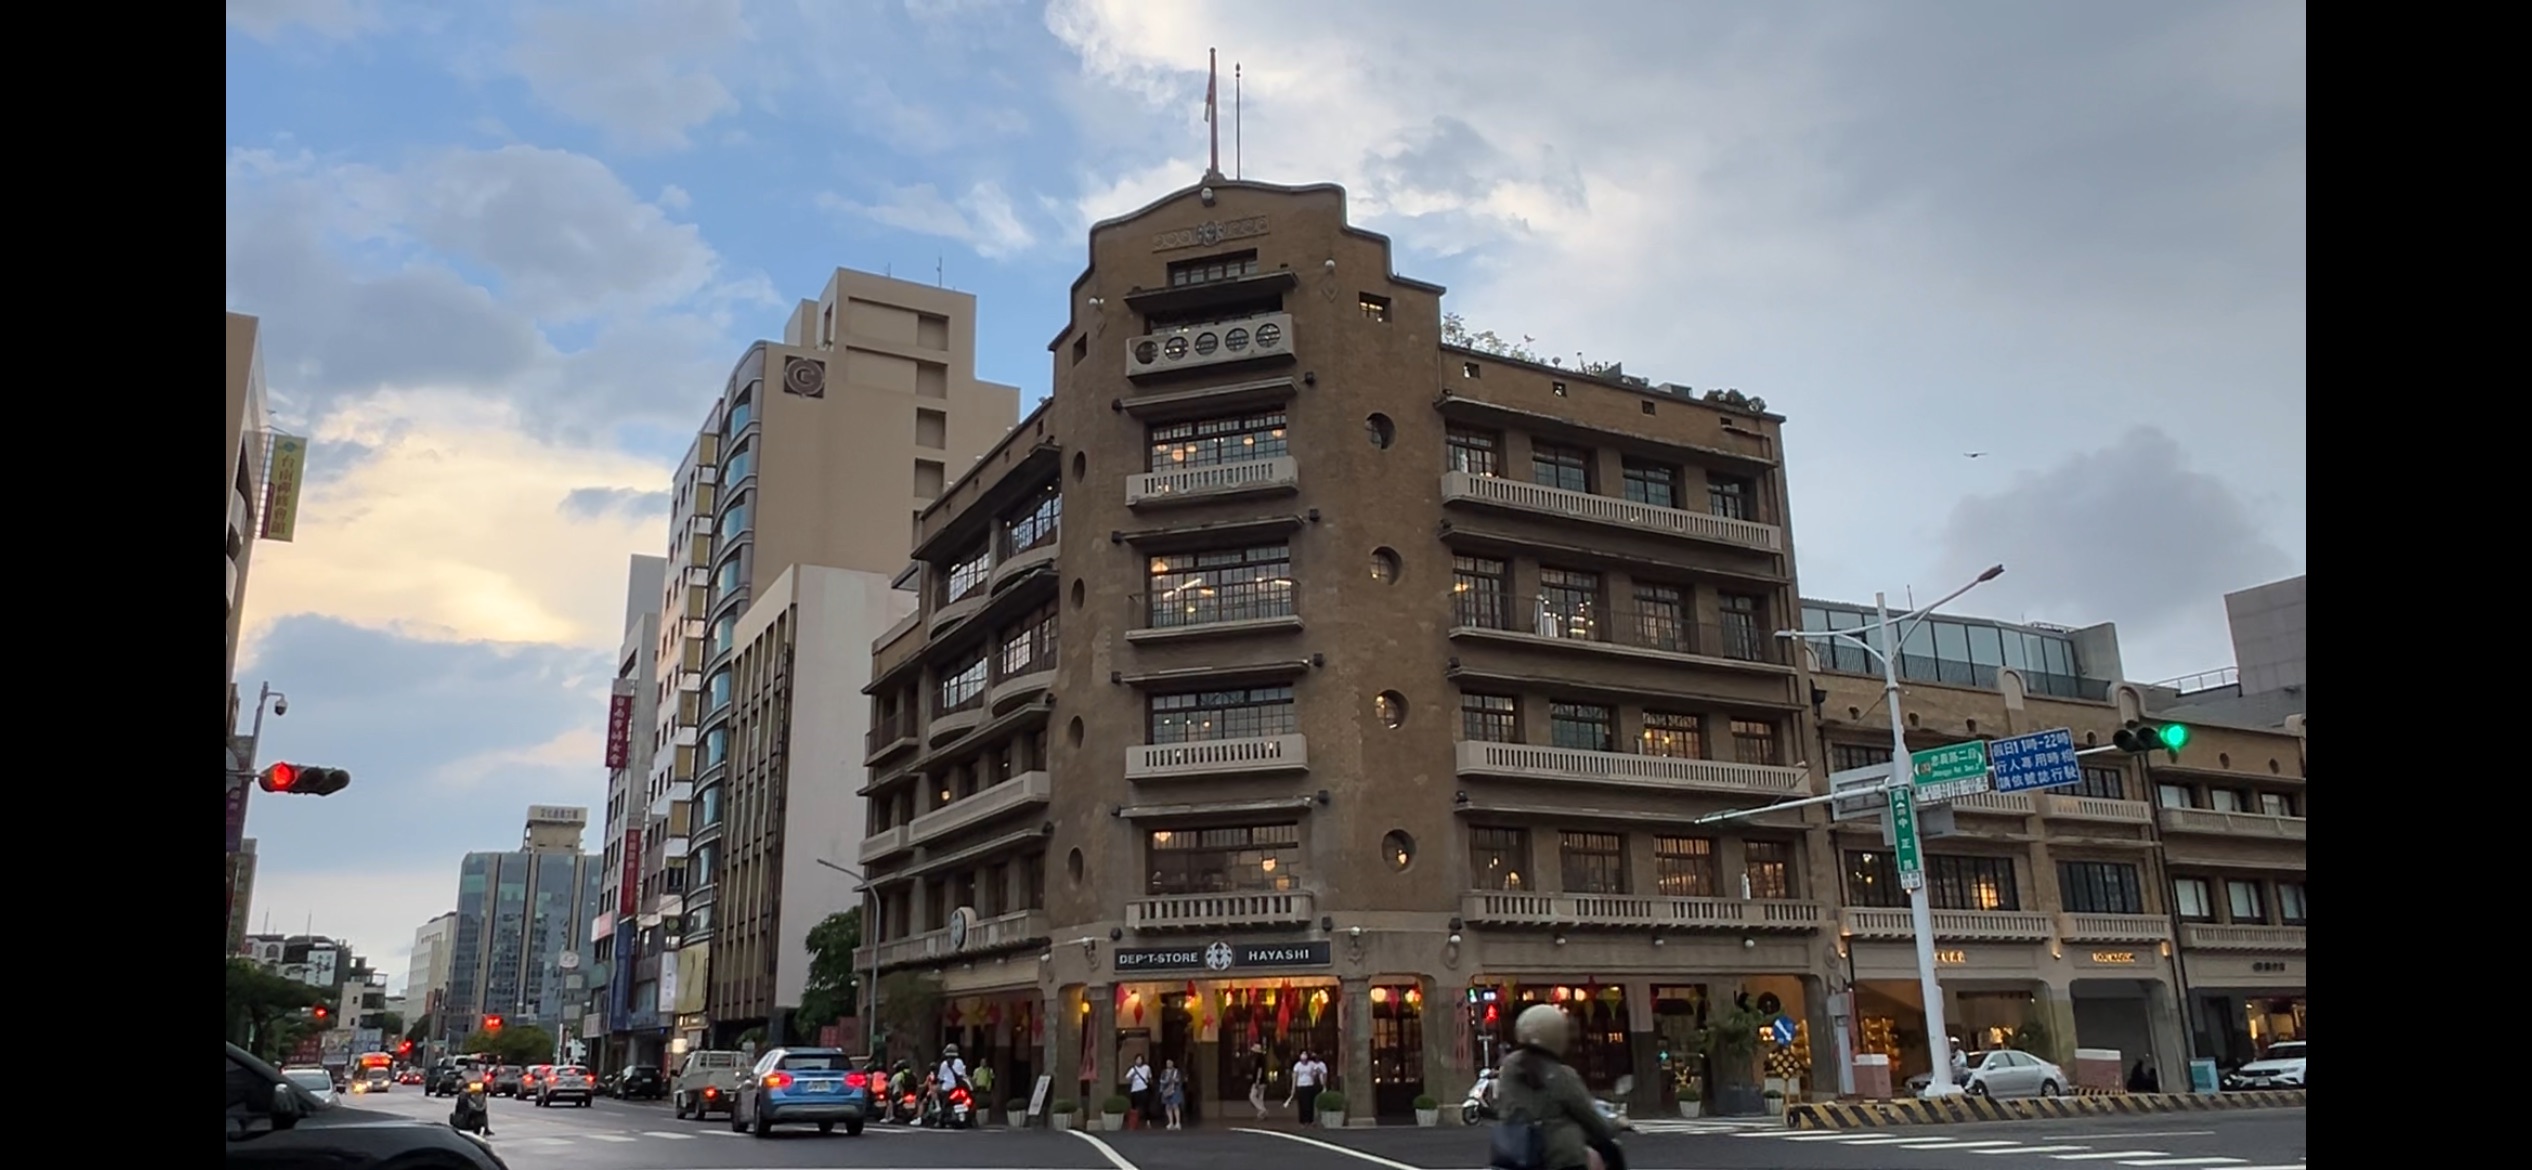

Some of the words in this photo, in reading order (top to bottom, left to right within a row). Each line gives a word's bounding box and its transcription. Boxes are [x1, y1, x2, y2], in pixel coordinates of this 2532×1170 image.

[1995, 749, 2075, 772] 行人專用時相
[1999, 765, 2078, 789] 請依號誌行駛
[1249, 949, 1310, 961] HAYASHI
